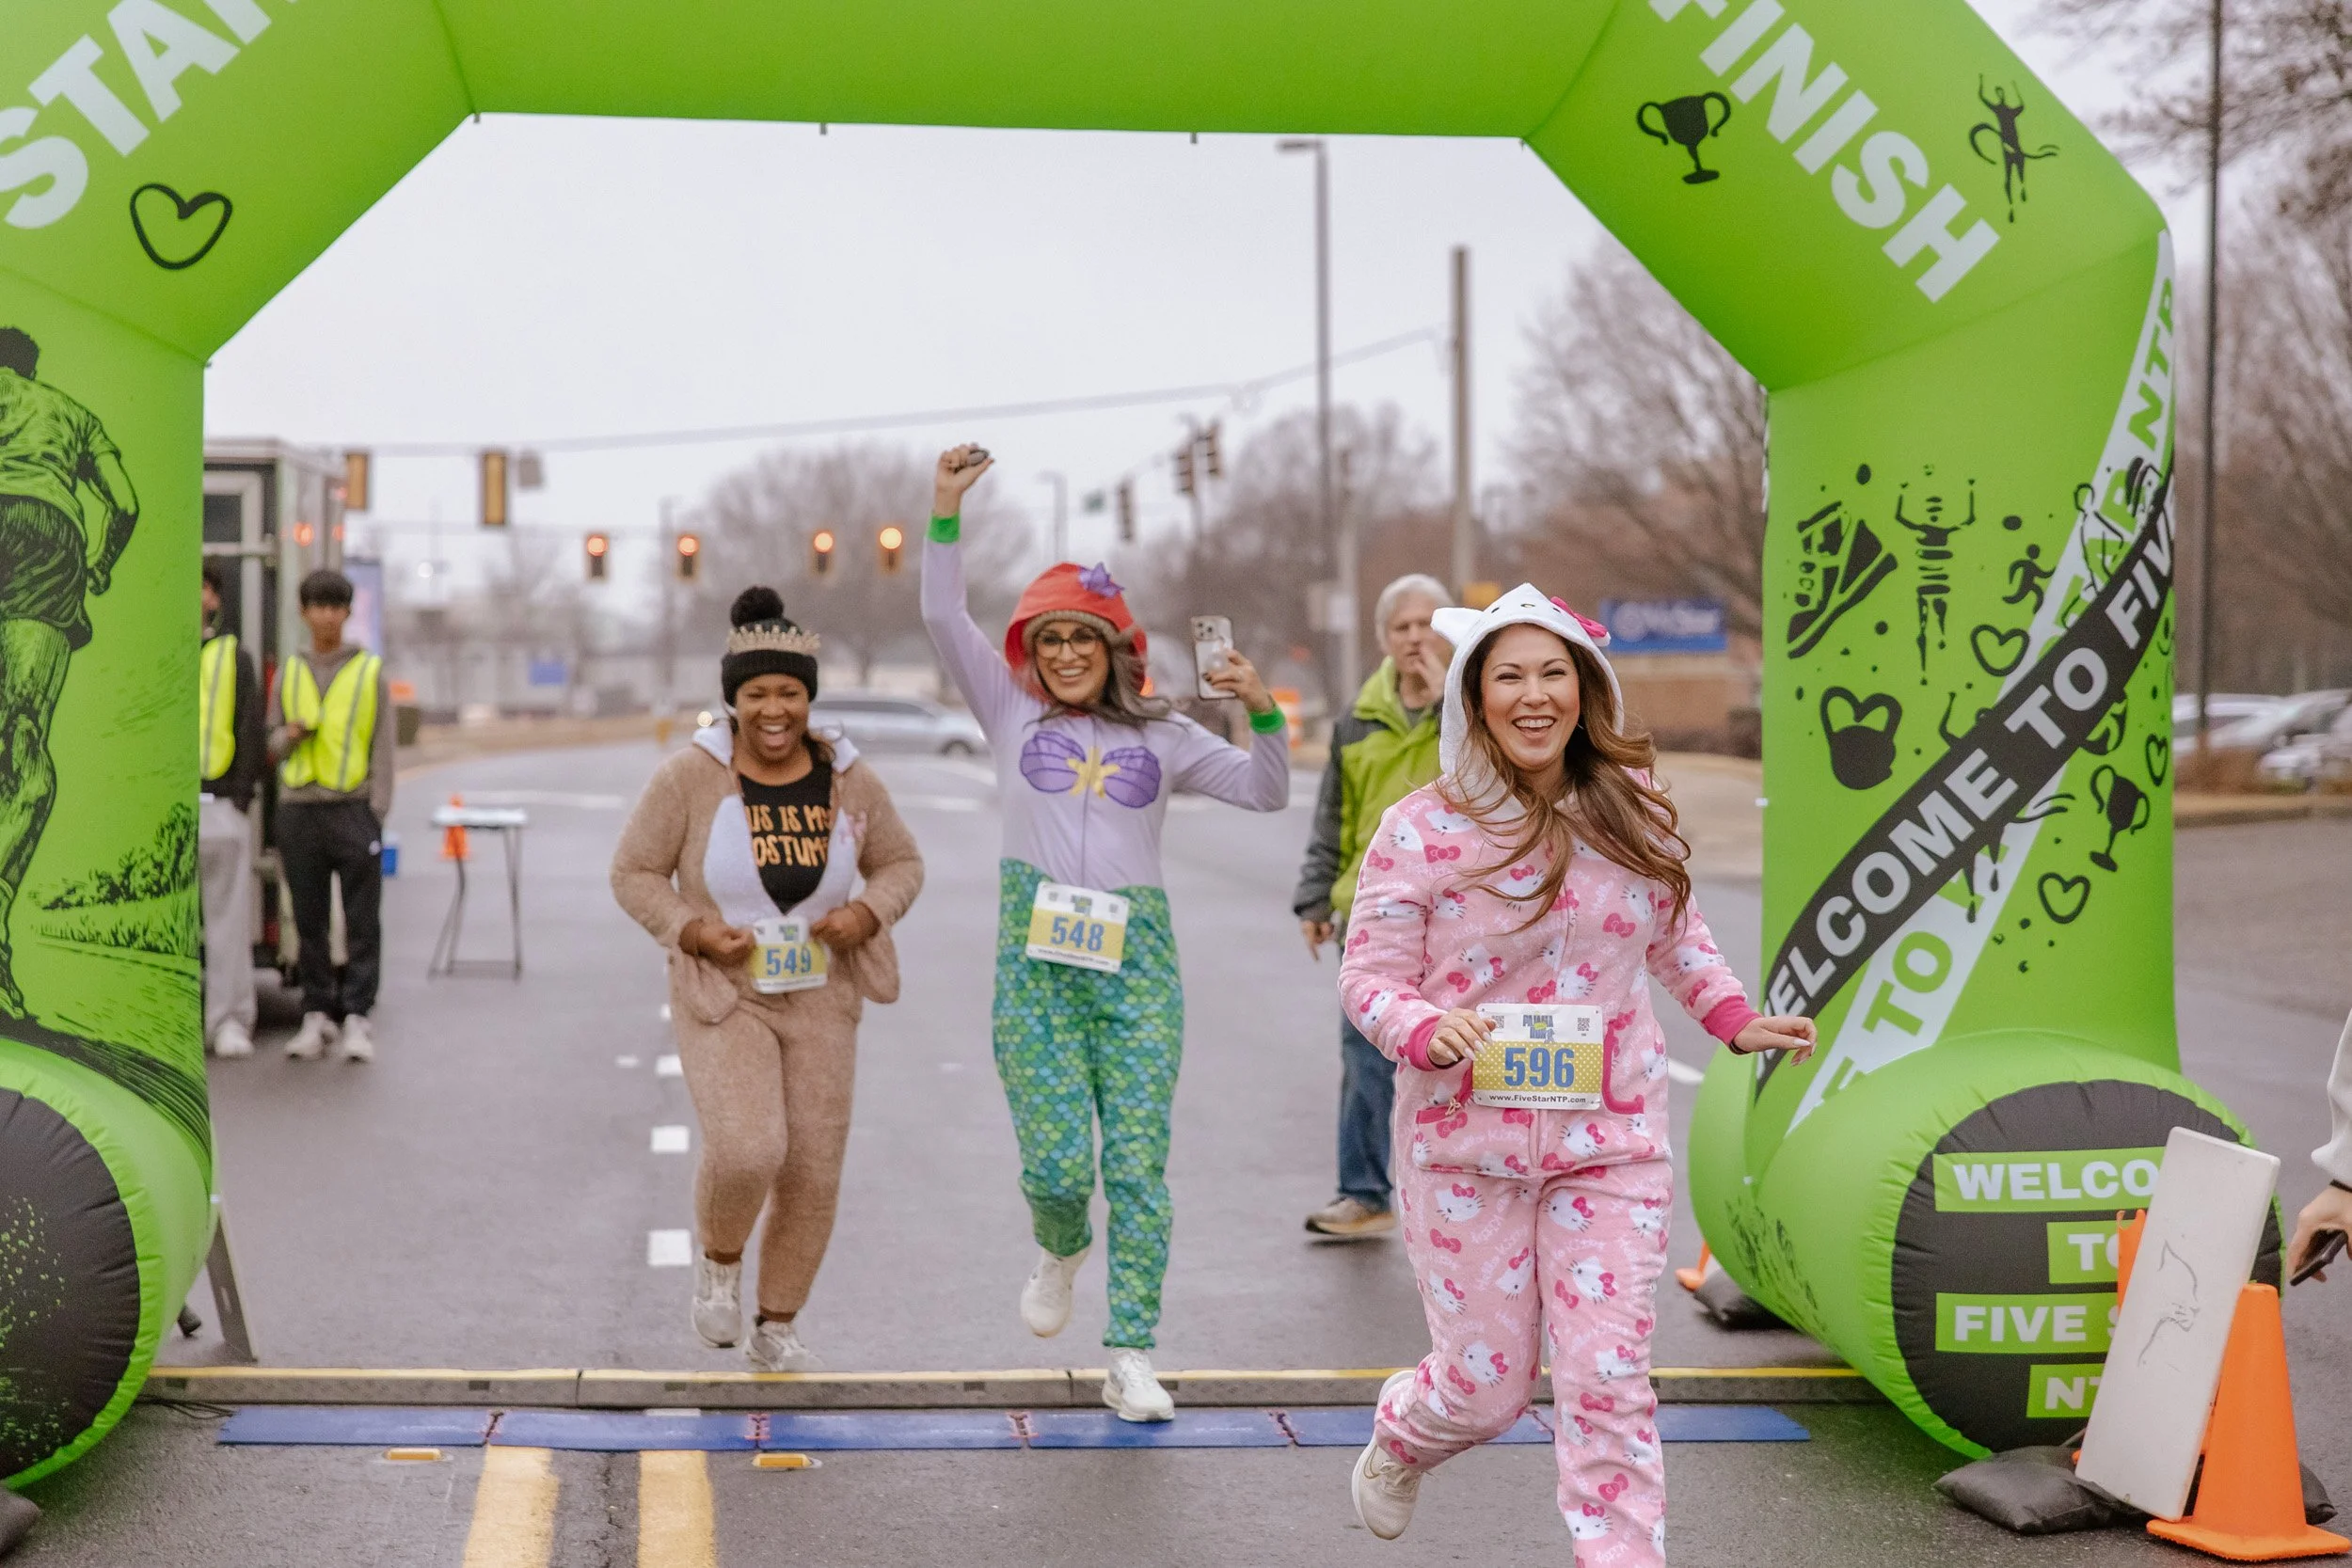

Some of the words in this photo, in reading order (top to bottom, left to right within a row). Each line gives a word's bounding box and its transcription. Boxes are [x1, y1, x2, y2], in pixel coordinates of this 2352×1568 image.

[0, 0, 272, 229] STA
[1648, 0, 2000, 303] INISH
[2004, 647, 2108, 749] TO
[778, 805, 803, 832] IS
[753, 834, 829, 867] OSTUM
[1050, 916, 1104, 952] 548
[767, 947, 812, 976] 549
[1862, 931, 1953, 1037] TO
[1504, 1047, 1575, 1088] 596
[1489, 1094, 1586, 1103] www.FiveStarNTP.com
[1952, 1159, 2160, 1201] WELCO
[1954, 1305, 2088, 1342] FIVE
